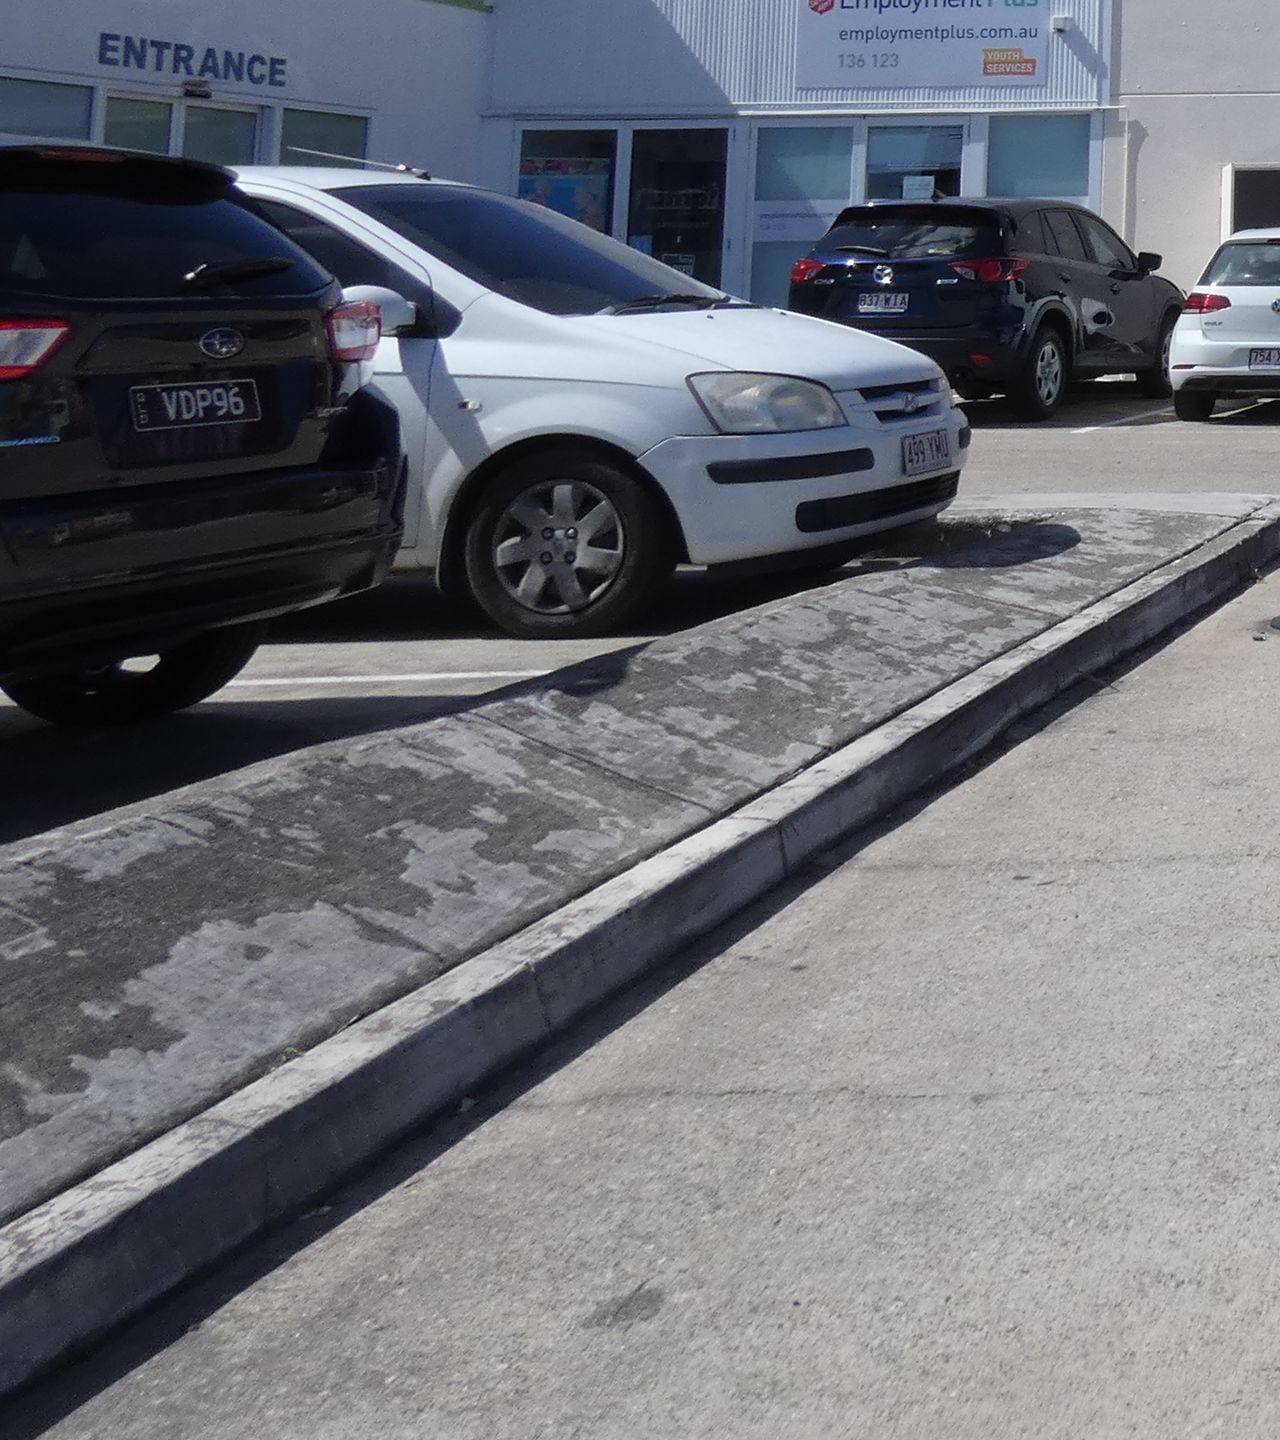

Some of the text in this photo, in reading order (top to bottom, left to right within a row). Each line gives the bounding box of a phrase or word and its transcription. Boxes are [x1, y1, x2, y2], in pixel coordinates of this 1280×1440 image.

[839, 25, 1038, 44] employmentplus.com.au
[99, 32, 287, 88] ENTRANCE
[838, 53, 899, 68] 136 123
[986, 50, 1020, 60] YOUTH
[986, 63, 1033, 73] SERVICES
[161, 387, 244, 420] VDP96
